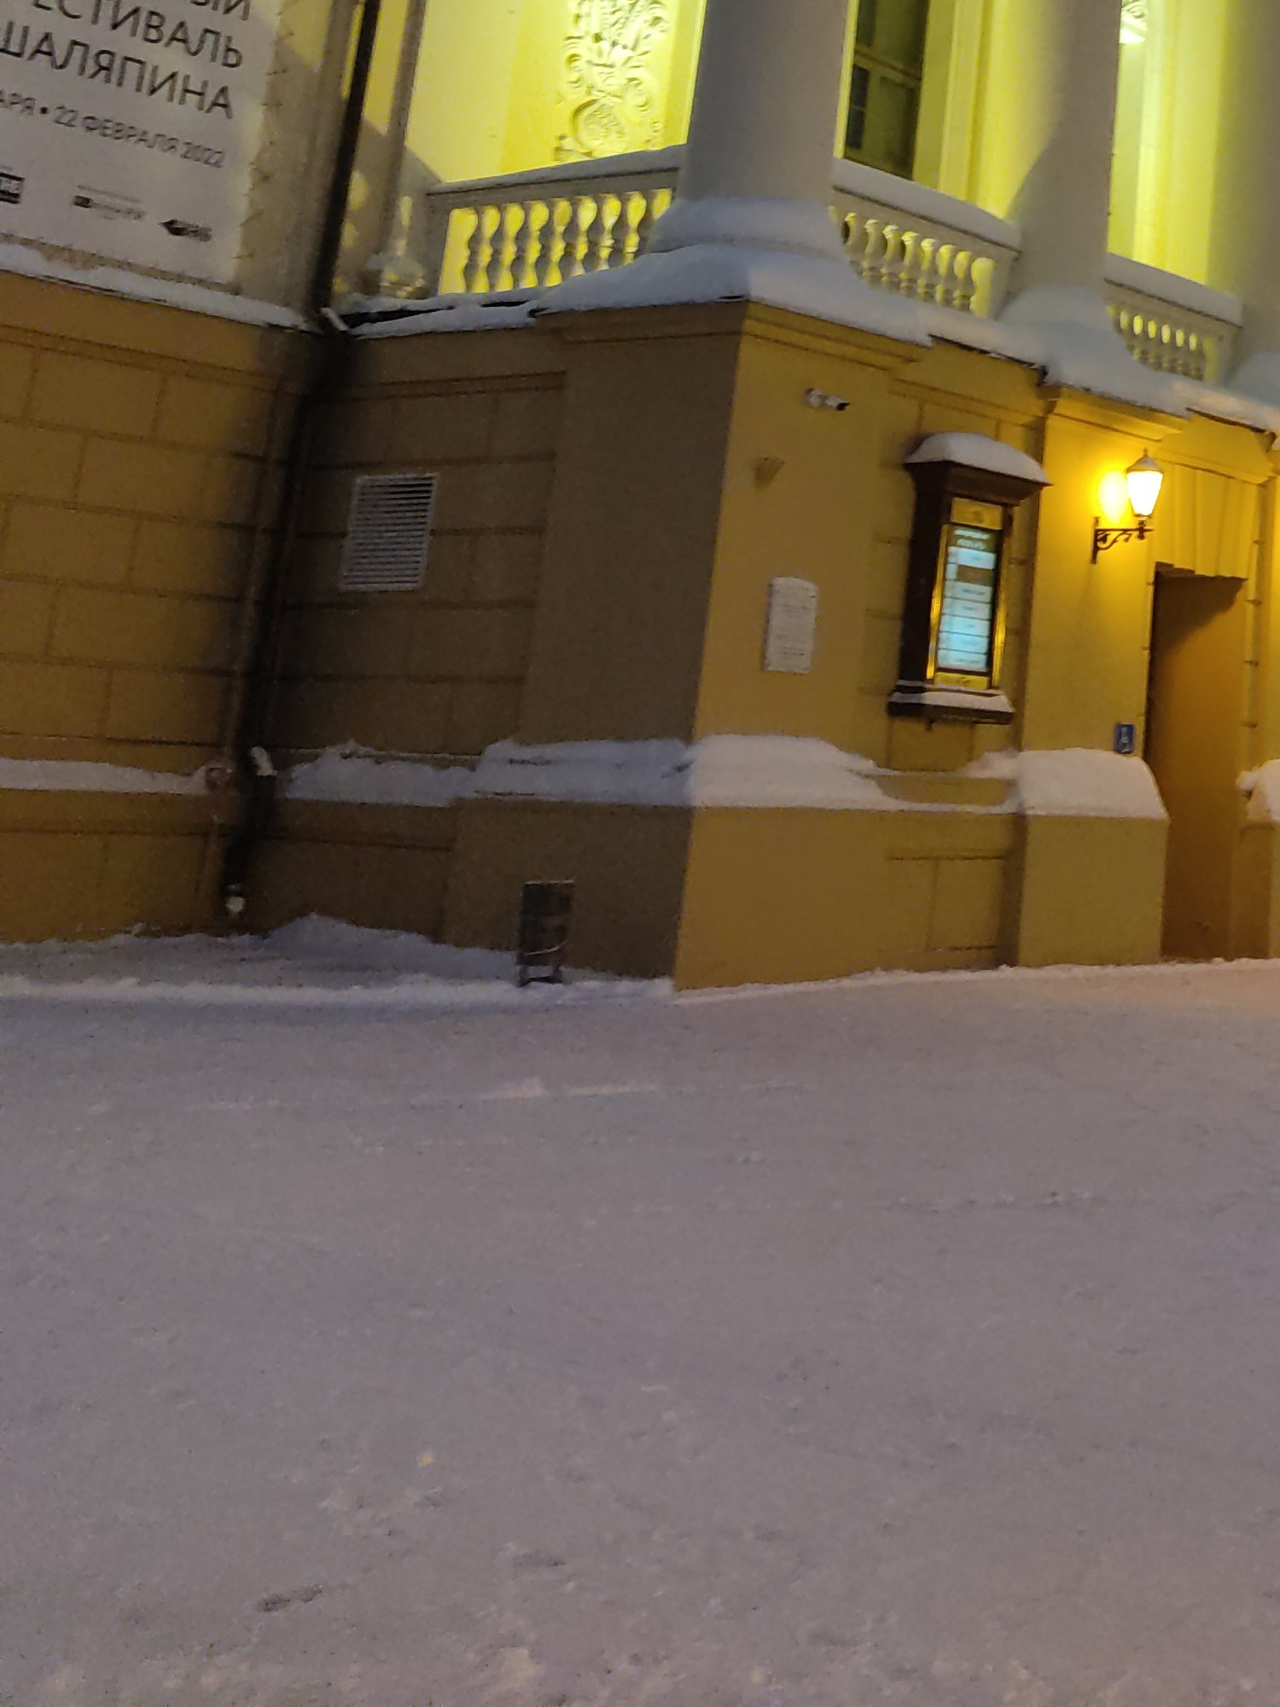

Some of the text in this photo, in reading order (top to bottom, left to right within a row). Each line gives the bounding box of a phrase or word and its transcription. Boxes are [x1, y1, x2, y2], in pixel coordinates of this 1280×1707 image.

[0, 21, 233, 119] ШАЛЯПИНА
[53, 106, 79, 128] 22
[82, 115, 179, 153] ФЕВРАЛЯ
